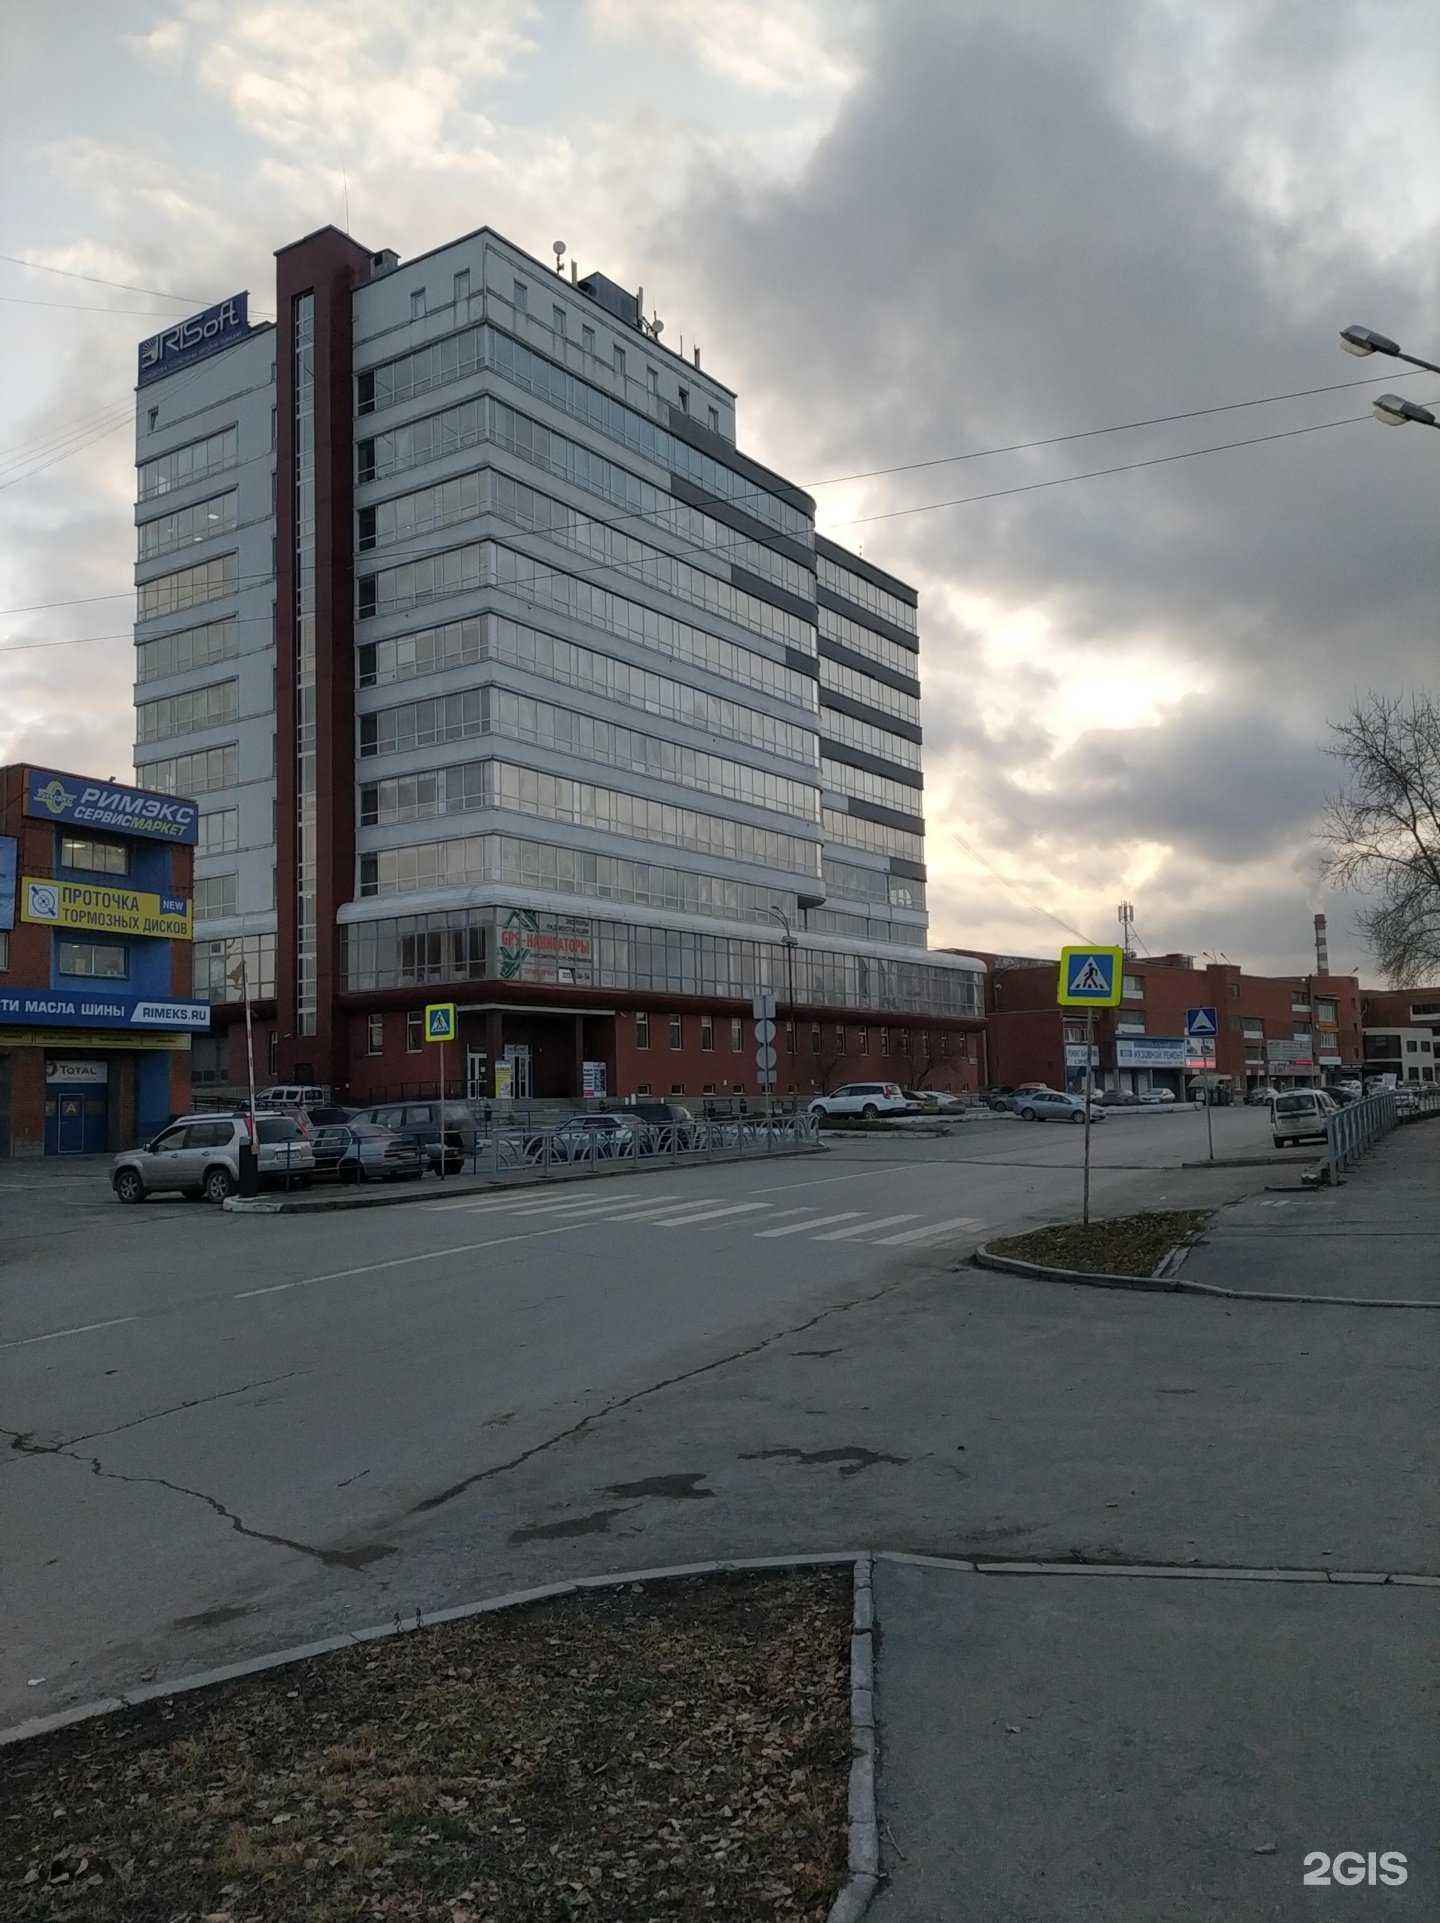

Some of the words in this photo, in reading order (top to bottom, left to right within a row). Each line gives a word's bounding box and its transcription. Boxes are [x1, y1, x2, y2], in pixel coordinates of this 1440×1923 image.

[80, 787, 194, 824] РИМЭКС
[74, 806, 188, 836] СЕРВИСМАРКЕТ
[62, 886, 140, 912] ПРОТОЧКА
[162, 899, 184, 911] NEW
[62, 907, 140, 930] ТОРМОЗНЫХ
[142, 919, 188, 935] ДИСКОВ
[25, 1000, 75, 1015] МАСЛА
[81, 1003, 125, 1017] ШИНЫ
[142, 1006, 207, 1021] RIMEKS.RU
